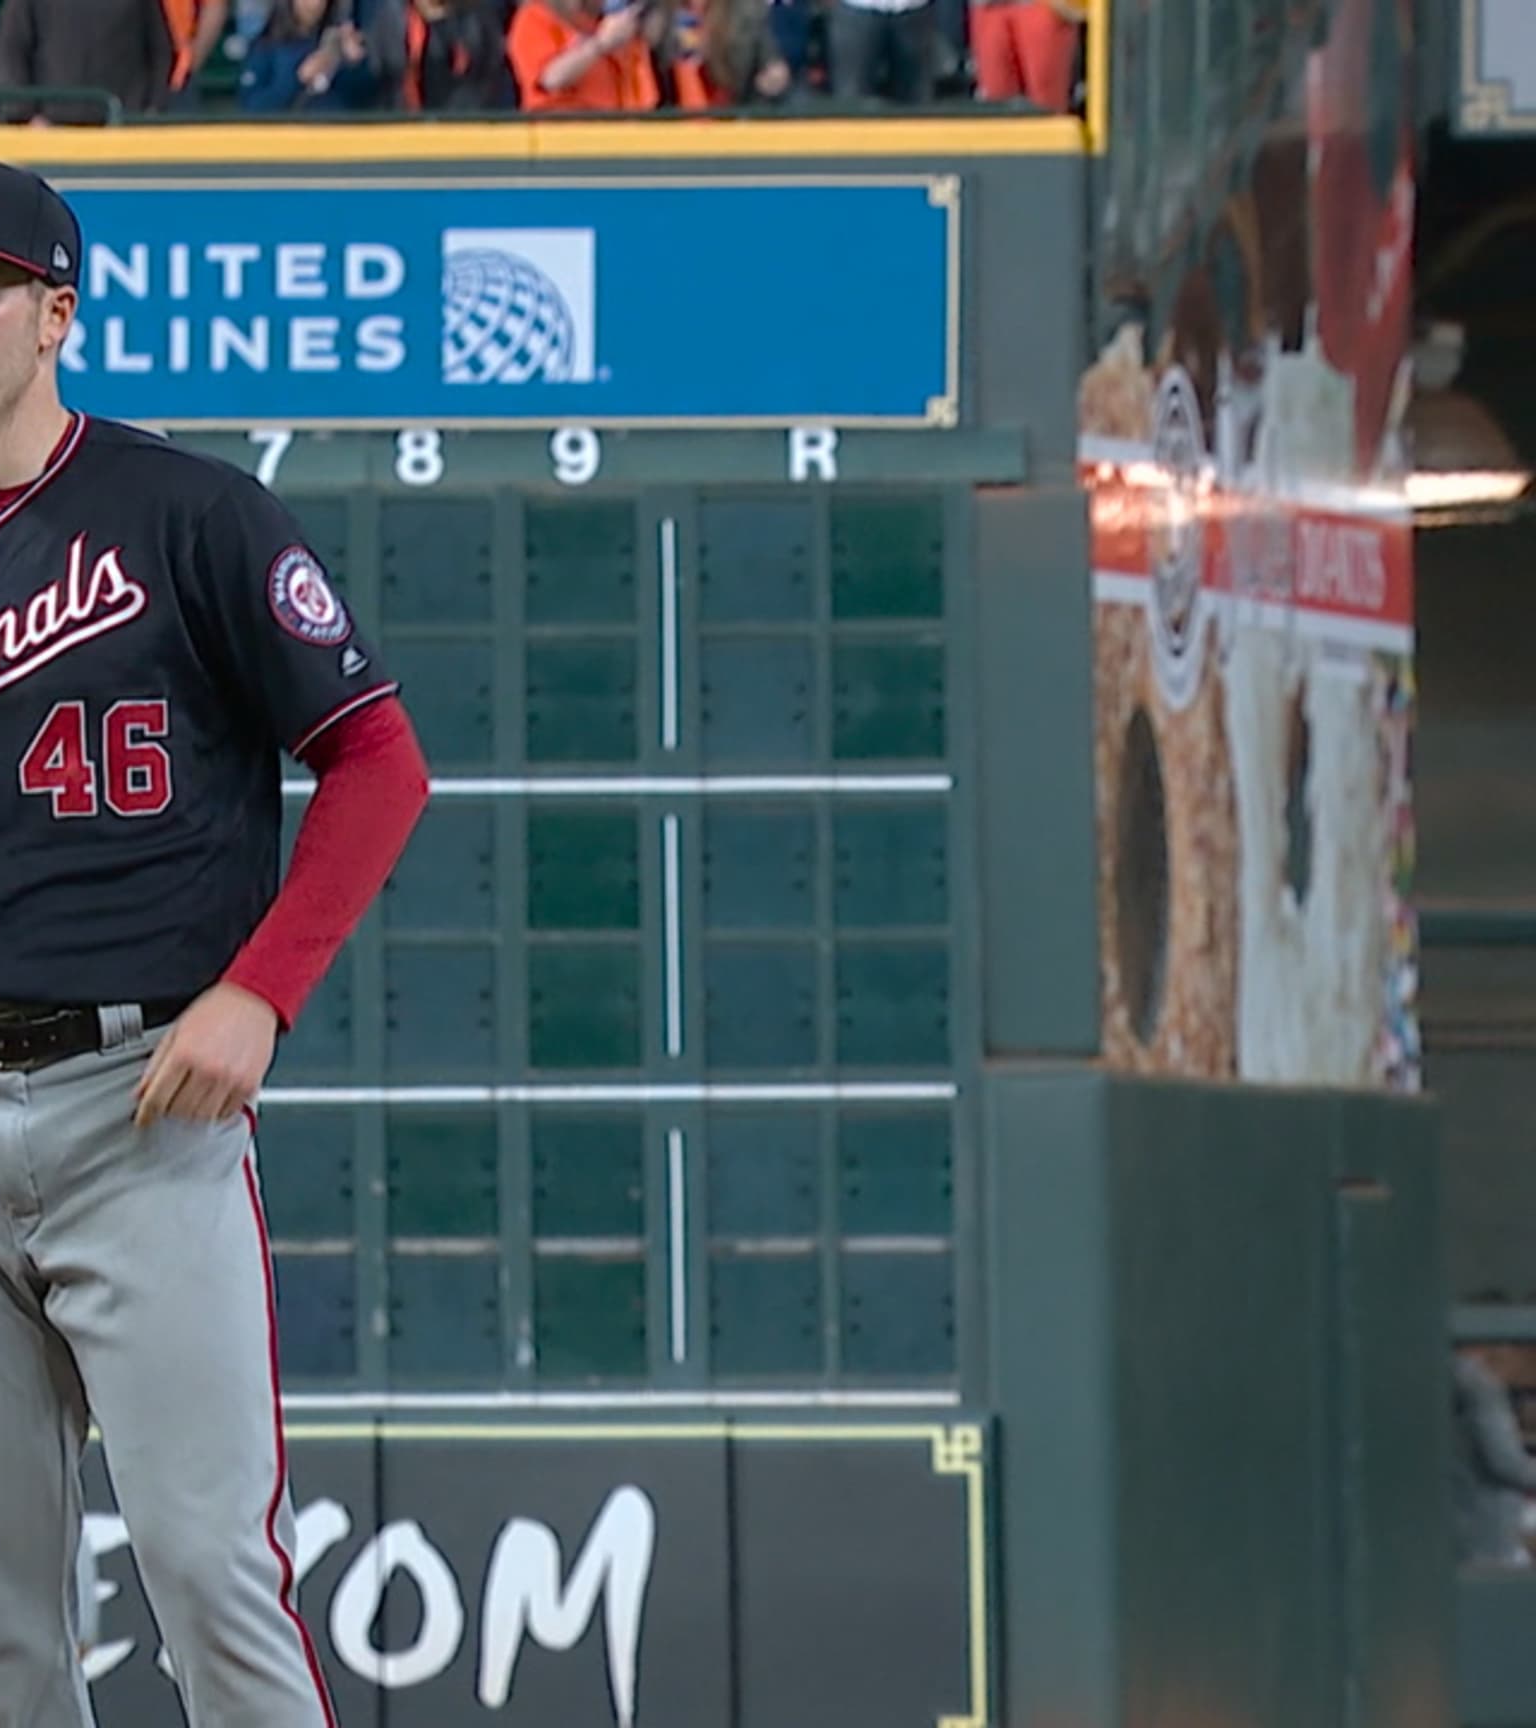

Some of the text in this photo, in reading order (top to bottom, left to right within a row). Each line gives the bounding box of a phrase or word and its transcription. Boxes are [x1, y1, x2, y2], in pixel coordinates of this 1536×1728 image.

[88, 243, 406, 300] NITED
[58, 315, 406, 373] RLINES
[249, 431, 294, 487] 7
[395, 428, 443, 486] 8
[550, 428, 600, 485] 9
[786, 428, 838, 482] R
[19, 699, 173, 819] 46
